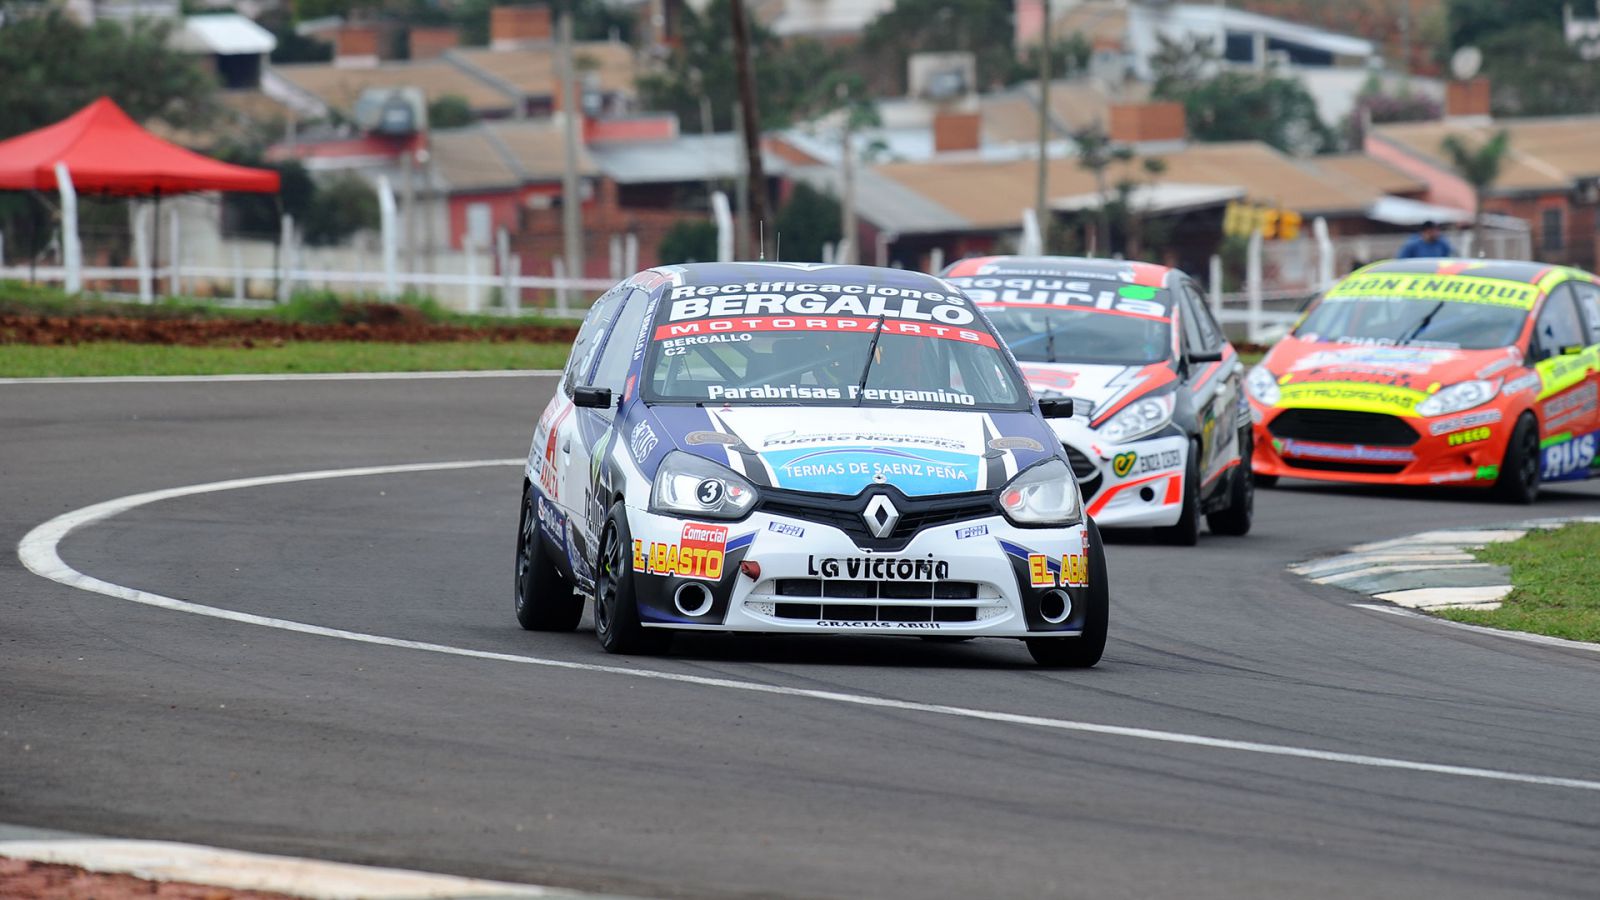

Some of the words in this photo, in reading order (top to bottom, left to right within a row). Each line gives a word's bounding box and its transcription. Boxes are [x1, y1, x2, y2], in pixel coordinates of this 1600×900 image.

[671, 281, 965, 306] Rectificaciones
[1340, 278, 1400, 291] DON
[669, 293, 974, 325] BERGALLO
[966, 289, 1165, 317] auria
[663, 333, 752, 348] BERGALLO
[670, 319, 980, 342] MOTORPARTS
[664, 347, 687, 356] C2
[708, 384, 840, 400] Parabrisas
[847, 385, 975, 405] Pergamino
[764, 435, 851, 447] Puente
[855, 435, 966, 449] Nogueira
[1448, 427, 1491, 446] IVECO
[1543, 434, 1594, 478] RUS
[785, 463, 845, 478] TERMAS
[849, 463, 869, 474] DE
[875, 463, 923, 476] SAENZ
[927, 464, 968, 480] PEÑA
[701, 481, 718, 502] 3
[682, 525, 726, 543] Comercial
[633, 539, 645, 572] EL
[647, 541, 724, 579] ABASTO
[808, 555, 840, 577] La
[1029, 554, 1055, 586] EL
[816, 620, 891, 629] GRACIAS
